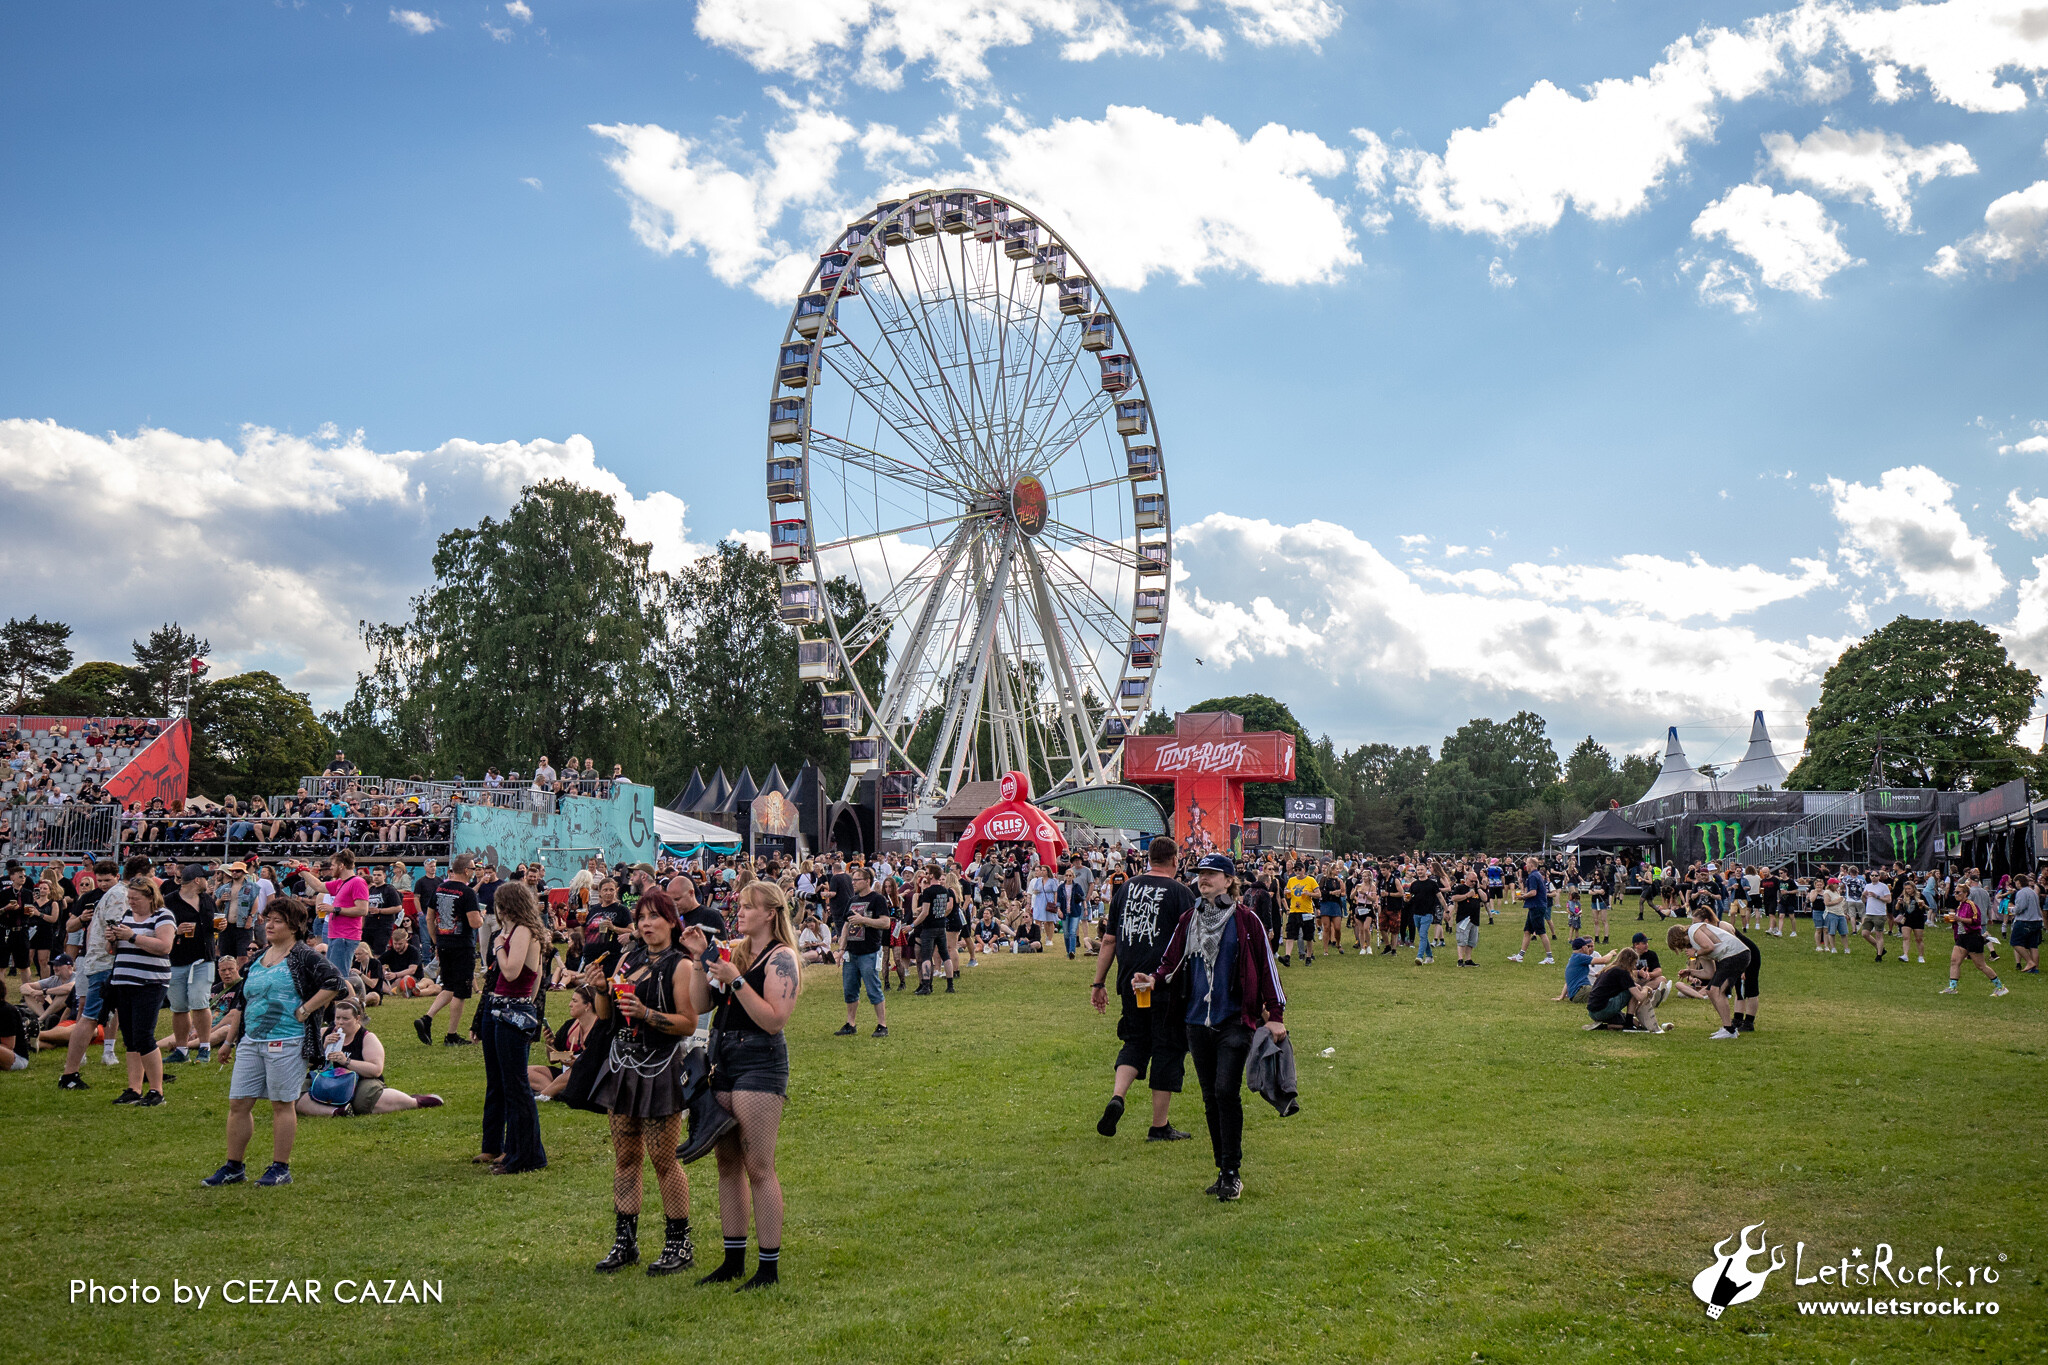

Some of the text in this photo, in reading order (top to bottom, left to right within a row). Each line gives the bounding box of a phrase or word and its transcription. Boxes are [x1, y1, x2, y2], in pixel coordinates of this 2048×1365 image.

[1197, 741, 1247, 772] ROCK
[1288, 812, 1323, 820] RECYCLING
[992, 818, 1023, 832] RIIS
[1128, 882, 1168, 901] PURE
[1124, 900, 1160, 915] FUCKING
